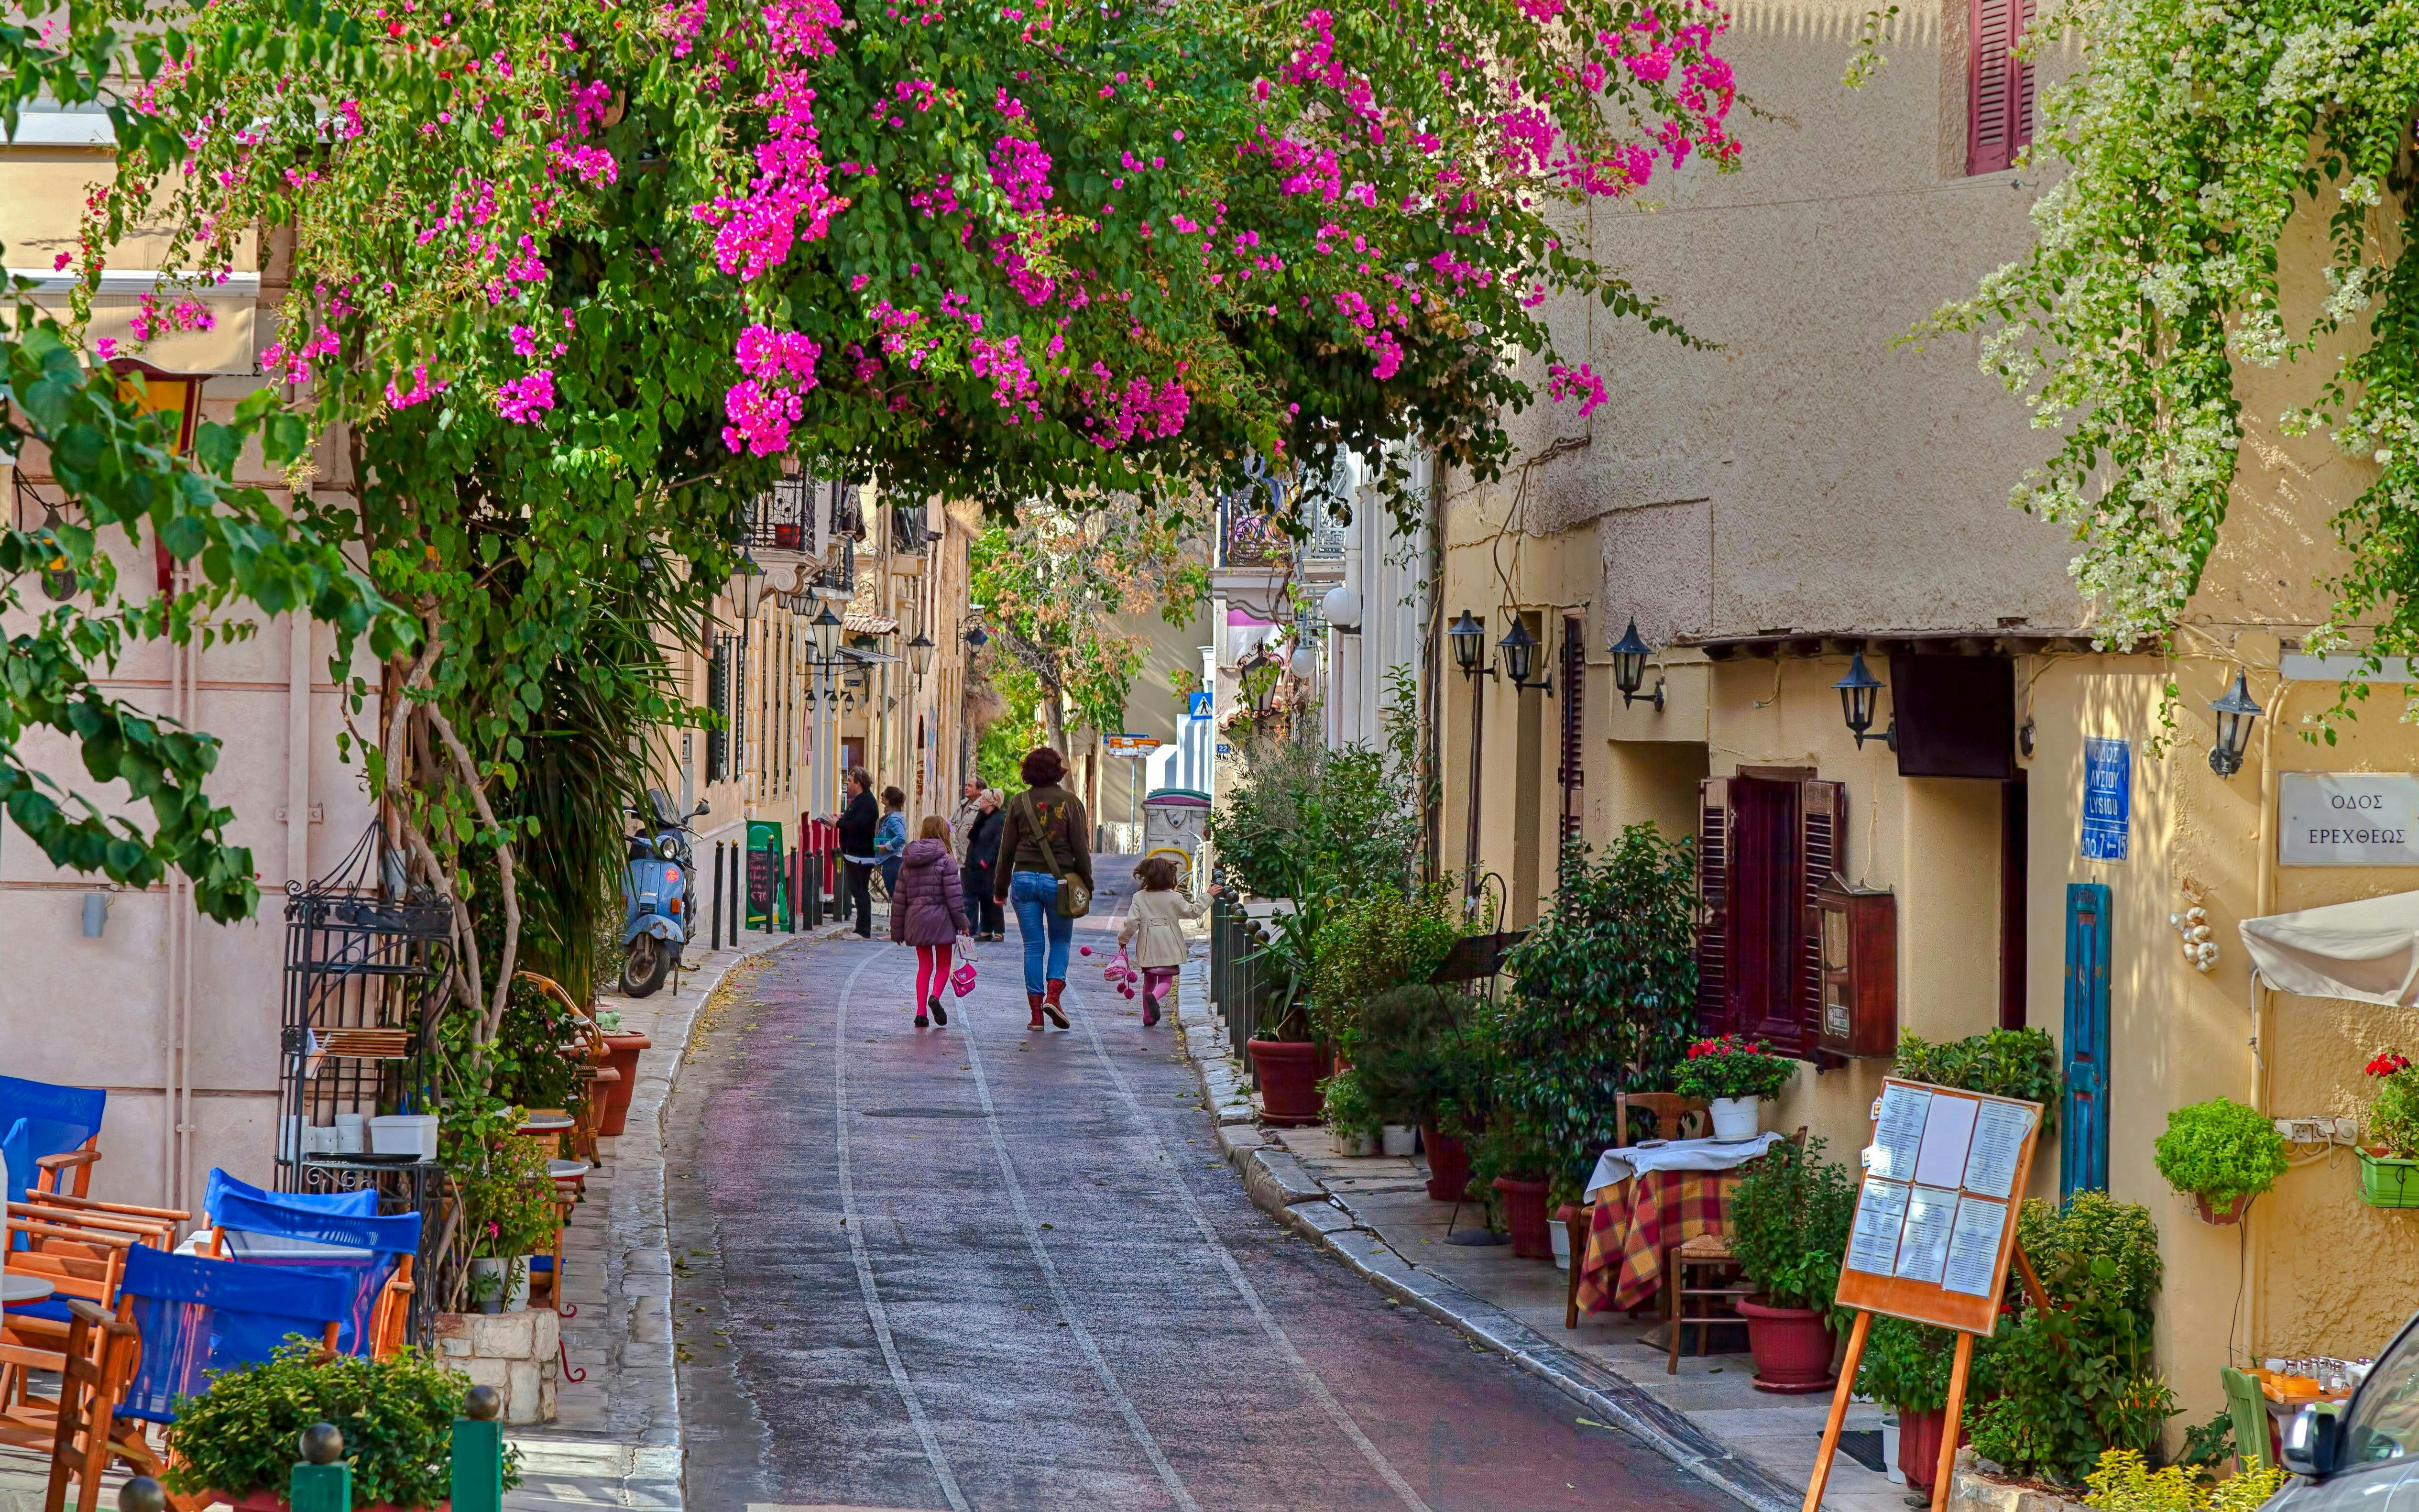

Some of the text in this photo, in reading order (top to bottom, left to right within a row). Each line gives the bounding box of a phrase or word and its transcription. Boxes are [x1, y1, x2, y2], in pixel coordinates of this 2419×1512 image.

[2094, 746, 2119, 764] ΟΔΟΣ
[2091, 769, 2119, 789] ΛΥΣΙΟΥ
[2090, 796, 2118, 816] LYSIOU
[2331, 795, 2383, 809] ΟΔΟΣ
[2100, 833, 2105, 858] 7
[2118, 834, 2127, 860] 15
[2309, 830, 2406, 844] ΕΡΕΧΘΕΩΣ
